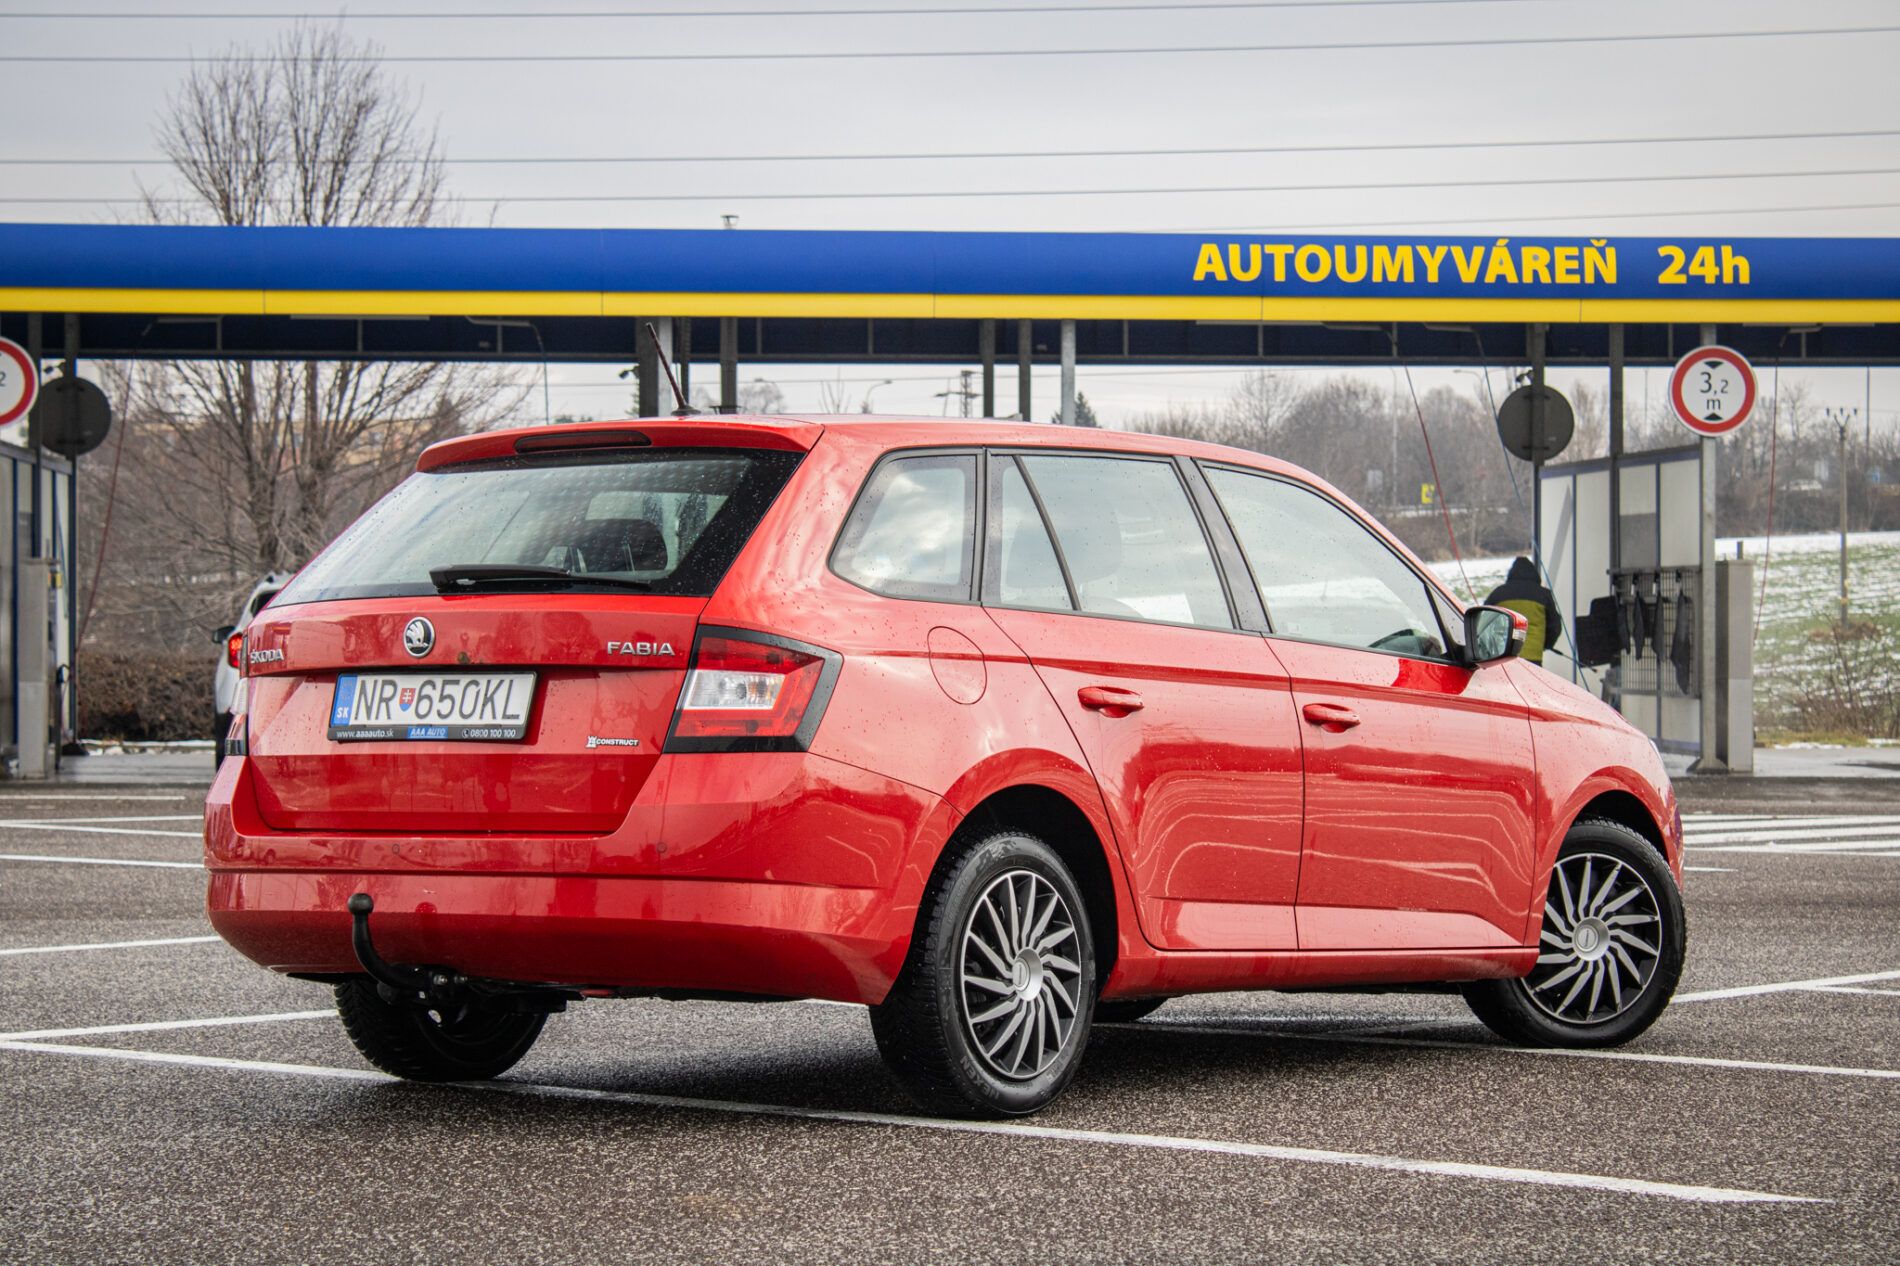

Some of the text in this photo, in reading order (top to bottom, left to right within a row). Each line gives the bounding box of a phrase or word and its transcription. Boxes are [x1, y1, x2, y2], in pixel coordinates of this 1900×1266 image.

[1193, 238, 1751, 285] AUTOUMYVÁREŇ 24h
[1706, 398, 1721, 411] m
[607, 641, 675, 656] FABIA
[354, 679, 520, 720] NR 650KL
[336, 706, 349, 719] SK
[336, 728, 394, 738] www.aaaauto.sk
[410, 728, 446, 737] AAA AUTO
[470, 729, 516, 738] 0800 100 100
[597, 738, 639, 747] CONSTRUCT
